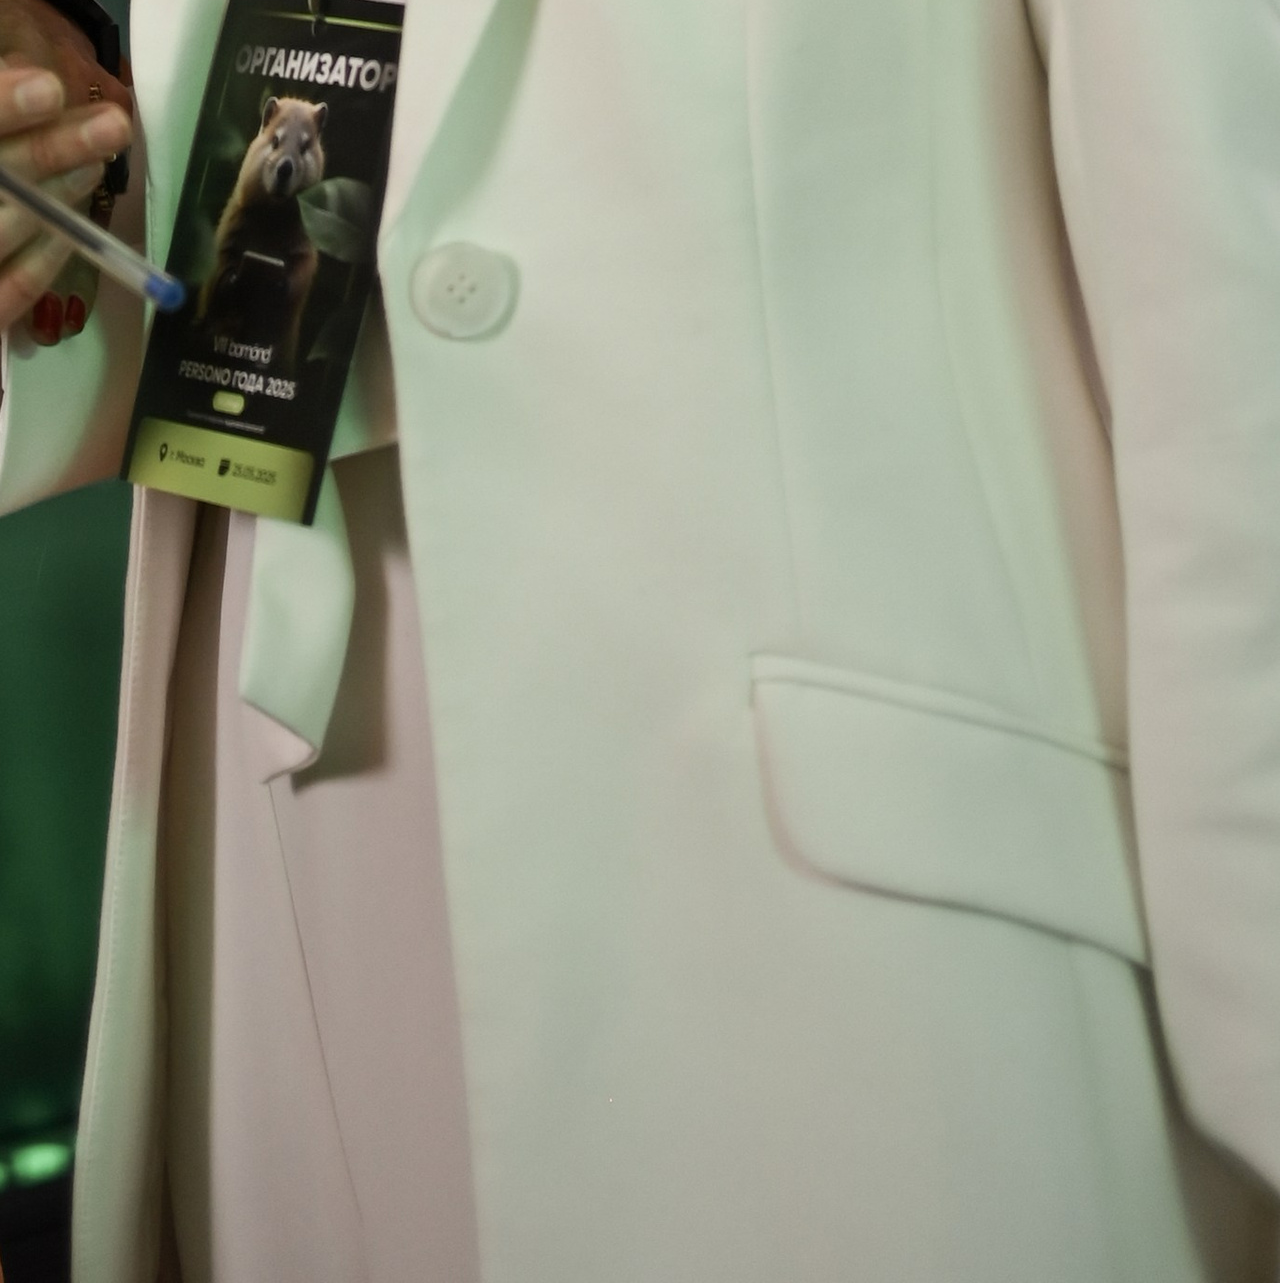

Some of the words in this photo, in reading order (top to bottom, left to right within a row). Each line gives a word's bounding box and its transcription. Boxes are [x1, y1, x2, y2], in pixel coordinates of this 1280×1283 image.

[235, 44, 398, 93] ОРГАНИЗАТОР
[178, 360, 231, 385] PERSONO
[232, 369, 264, 395] ГОДА
[265, 377, 296, 400] 2025
